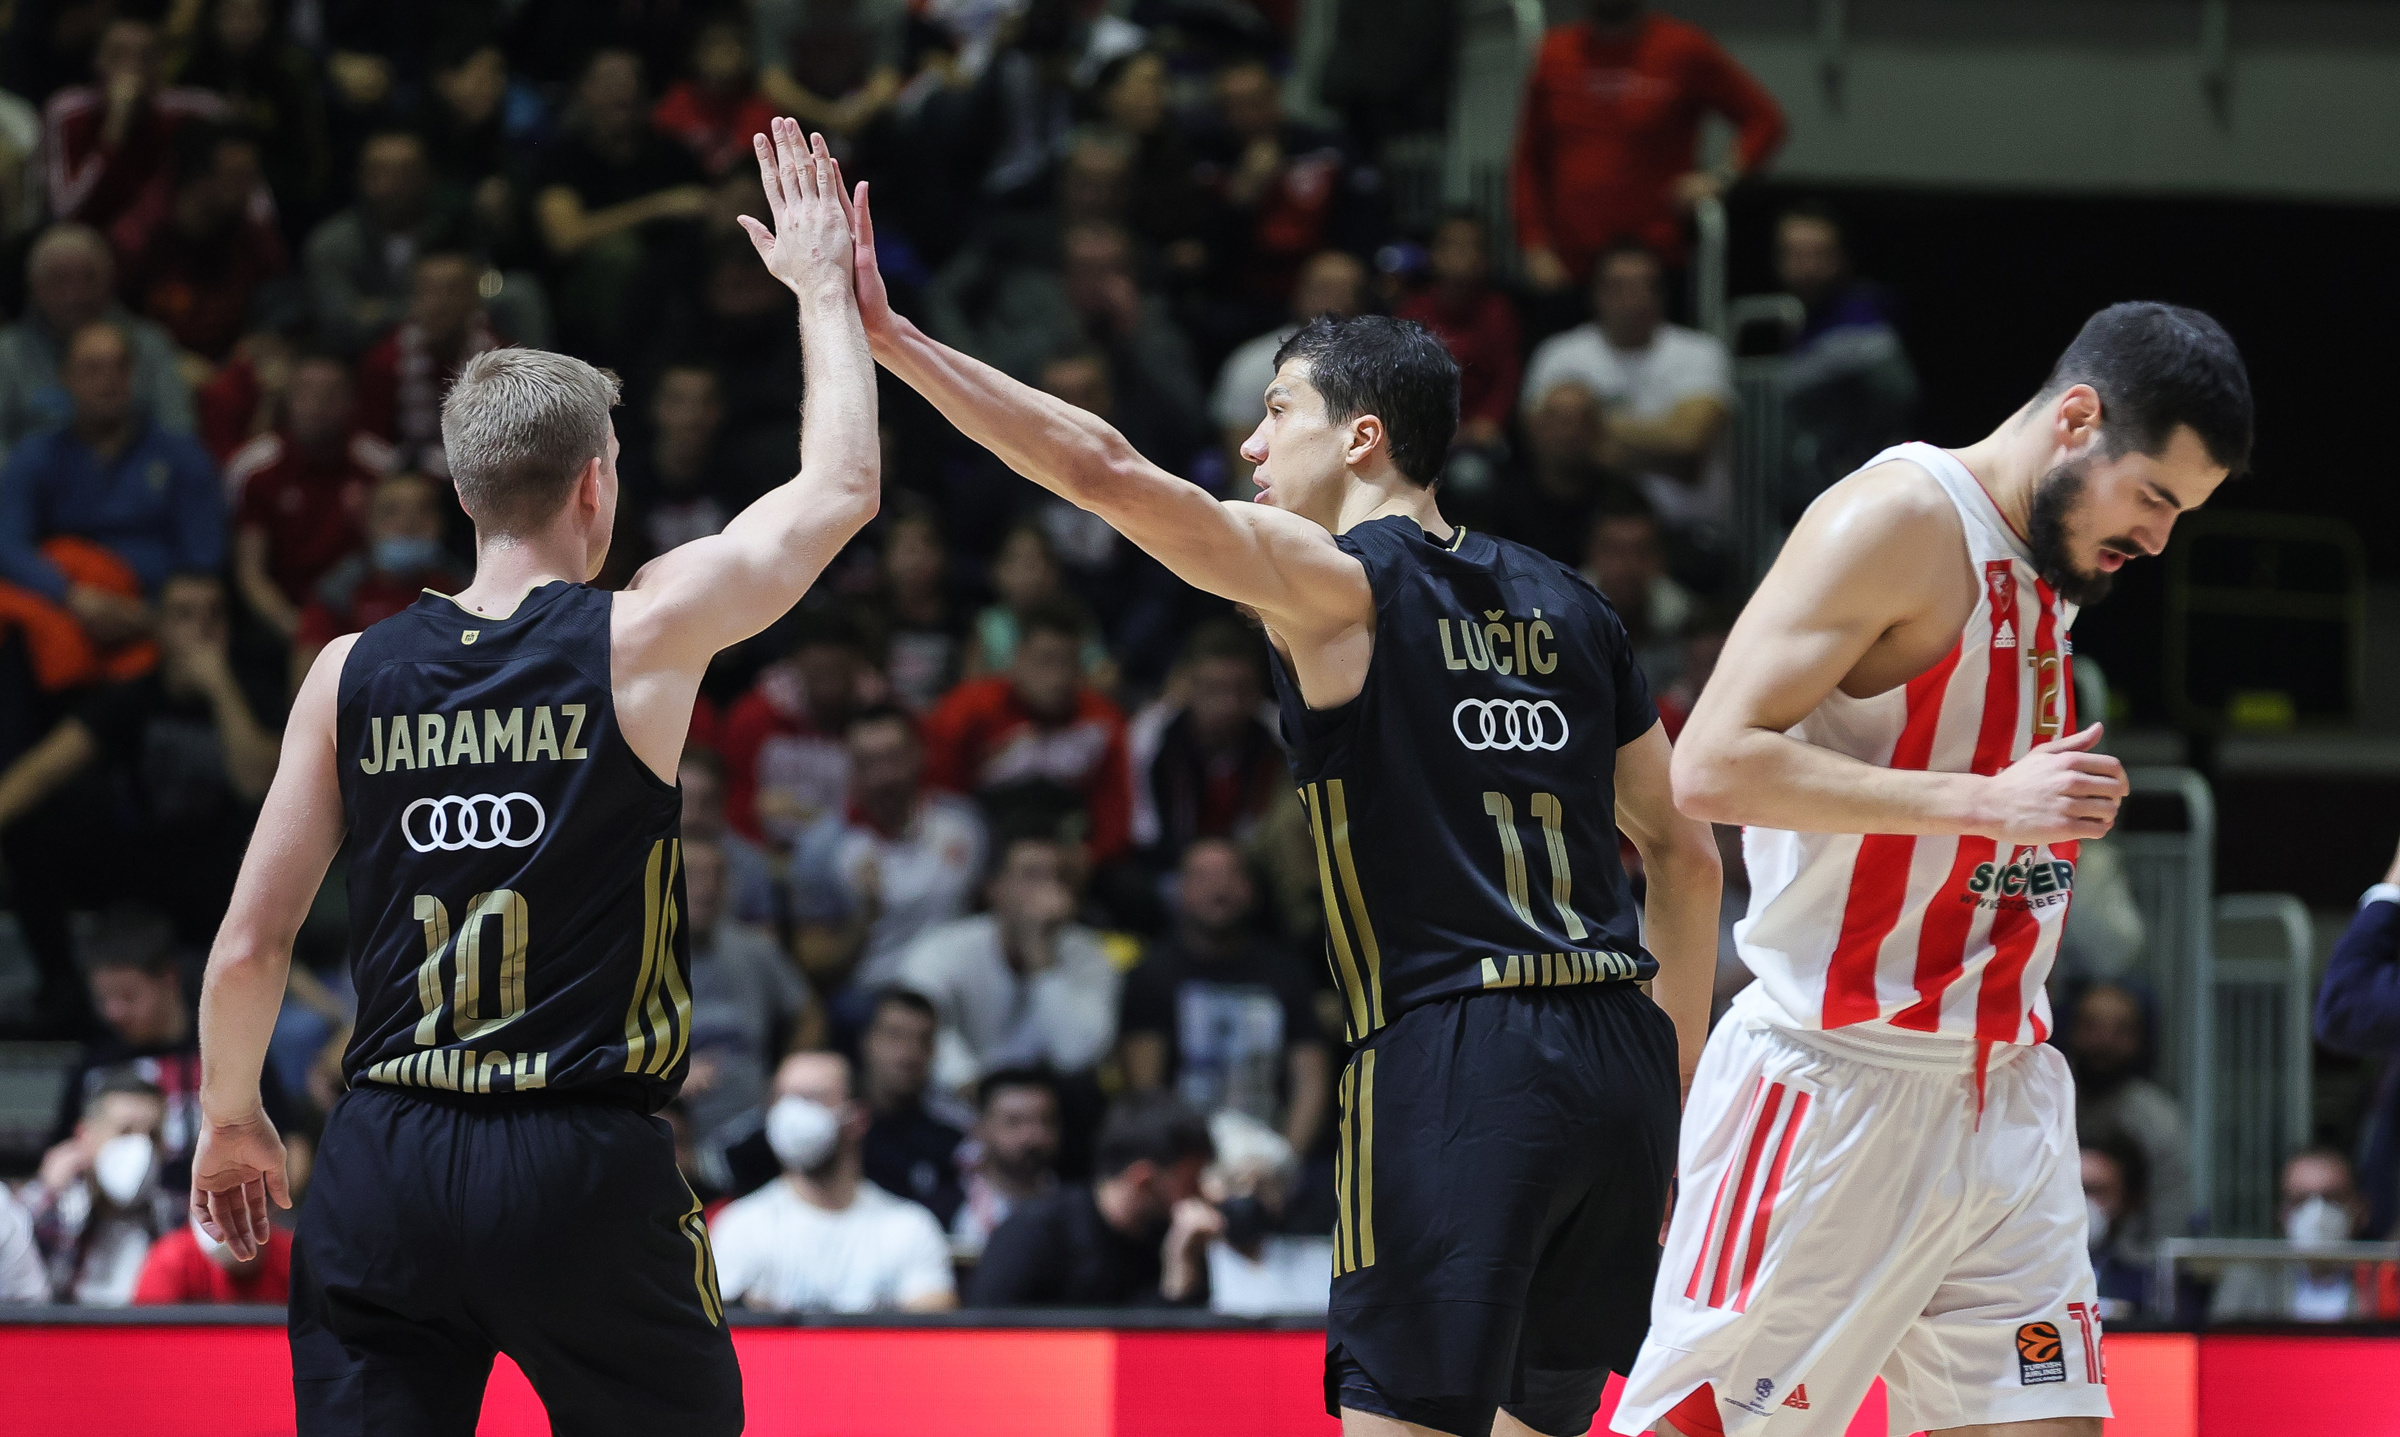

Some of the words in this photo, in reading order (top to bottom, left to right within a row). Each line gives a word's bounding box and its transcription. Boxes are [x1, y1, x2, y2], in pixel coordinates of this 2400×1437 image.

[1437, 607, 1557, 676] LUČIĆ
[360, 703, 588, 775] JARAMAZ
[1482, 791, 1589, 941] 11
[413, 888, 529, 1046] 10
